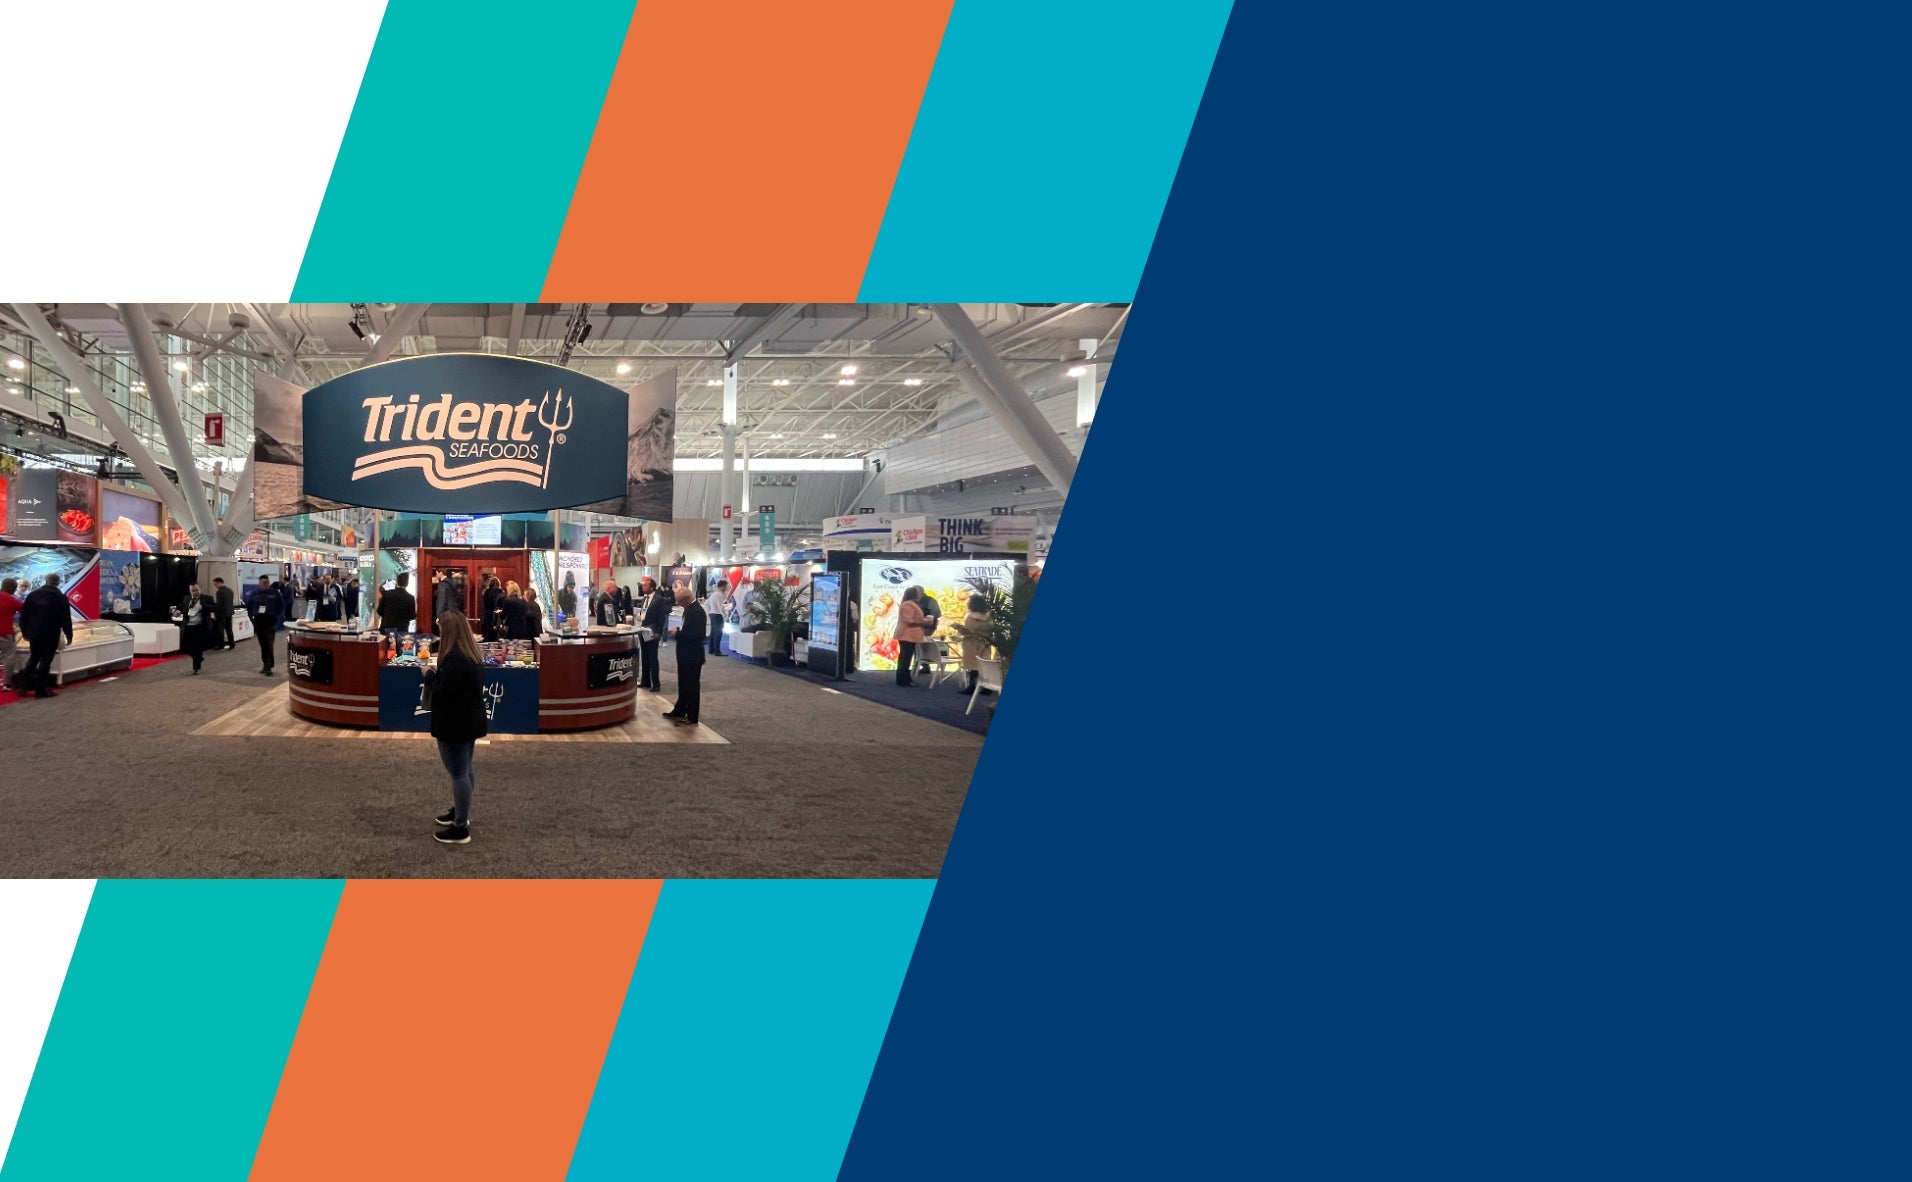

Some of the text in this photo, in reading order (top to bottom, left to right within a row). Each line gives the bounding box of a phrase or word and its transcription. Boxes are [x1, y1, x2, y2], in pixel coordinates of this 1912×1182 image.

[361, 393, 537, 442] Trident
[449, 442, 539, 460] SEAFOODS
[938, 518, 984, 536] THINK
[940, 536, 964, 553] BIG
[964, 566, 1002, 576] SEATRADE
[609, 656, 633, 671] Trident
